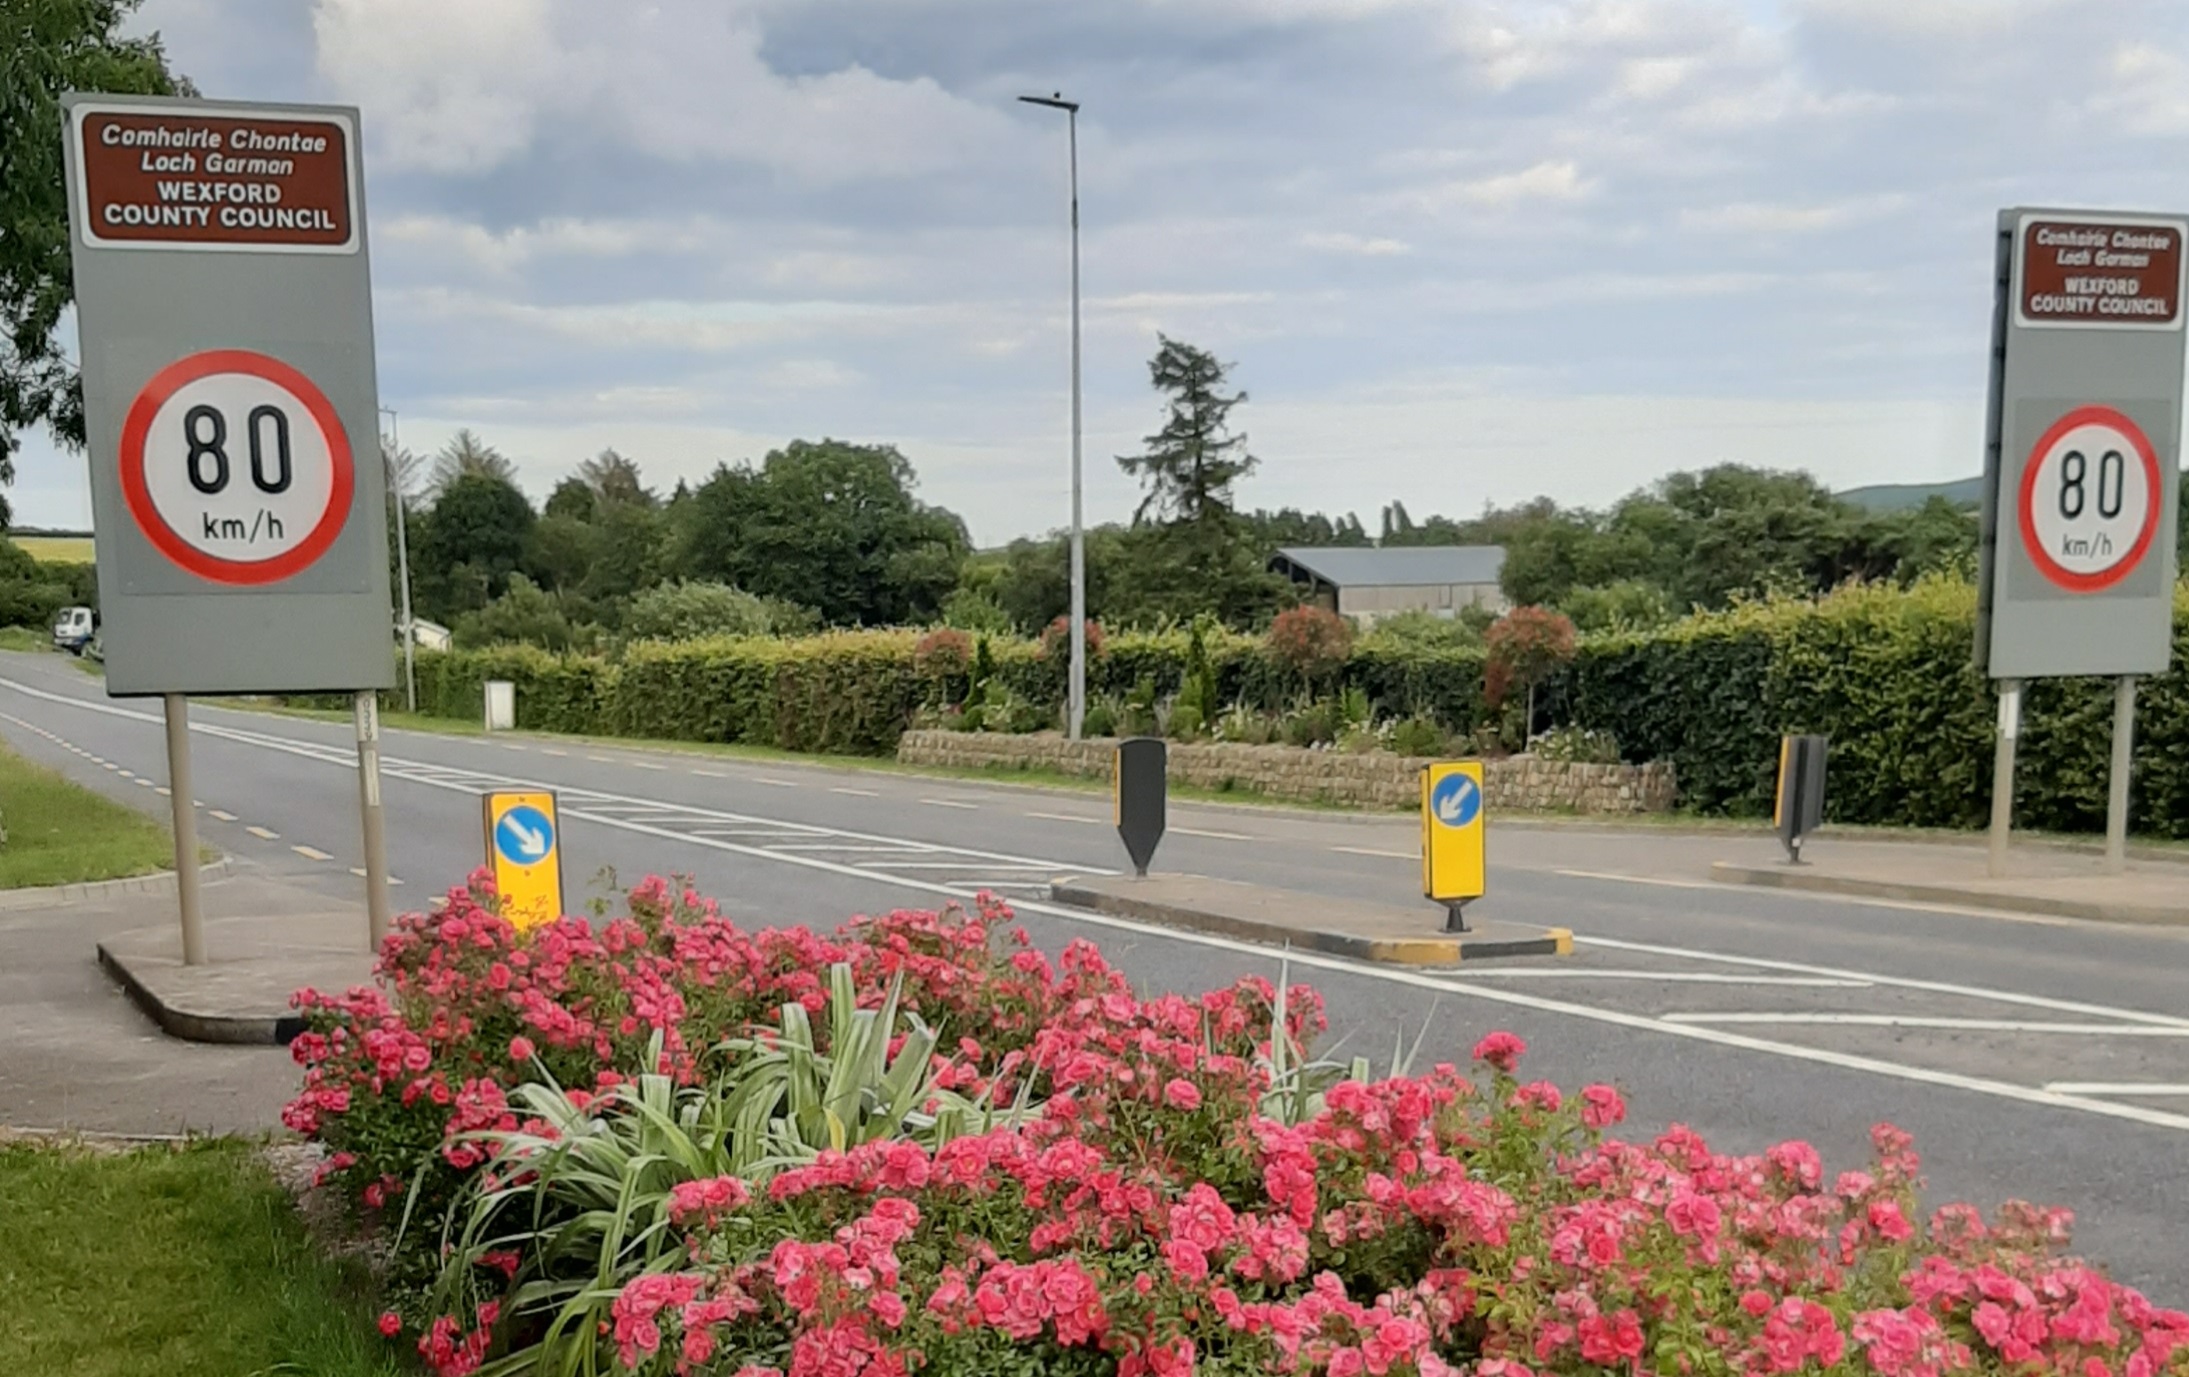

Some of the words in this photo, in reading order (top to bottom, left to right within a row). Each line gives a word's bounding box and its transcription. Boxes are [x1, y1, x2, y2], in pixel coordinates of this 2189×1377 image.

[101, 124, 222, 149] Comhairle
[230, 129, 327, 152] Chontae
[141, 152, 196, 172] Loch
[205, 156, 294, 175] Garman
[157, 181, 282, 204] WEXFORD
[104, 204, 211, 226] COUNTY
[220, 207, 337, 229] COUNCIL
[2057, 249, 2091, 266] Loch
[2065, 277, 2139, 296] WEXFORD
[2031, 296, 2095, 314] COUNTY
[2098, 298, 2169, 316] COUNCIL
[184, 404, 292, 495] 80
[2059, 450, 2124, 520] 80
[203, 508, 284, 544] km/h
[2062, 531, 2113, 559] km/h
